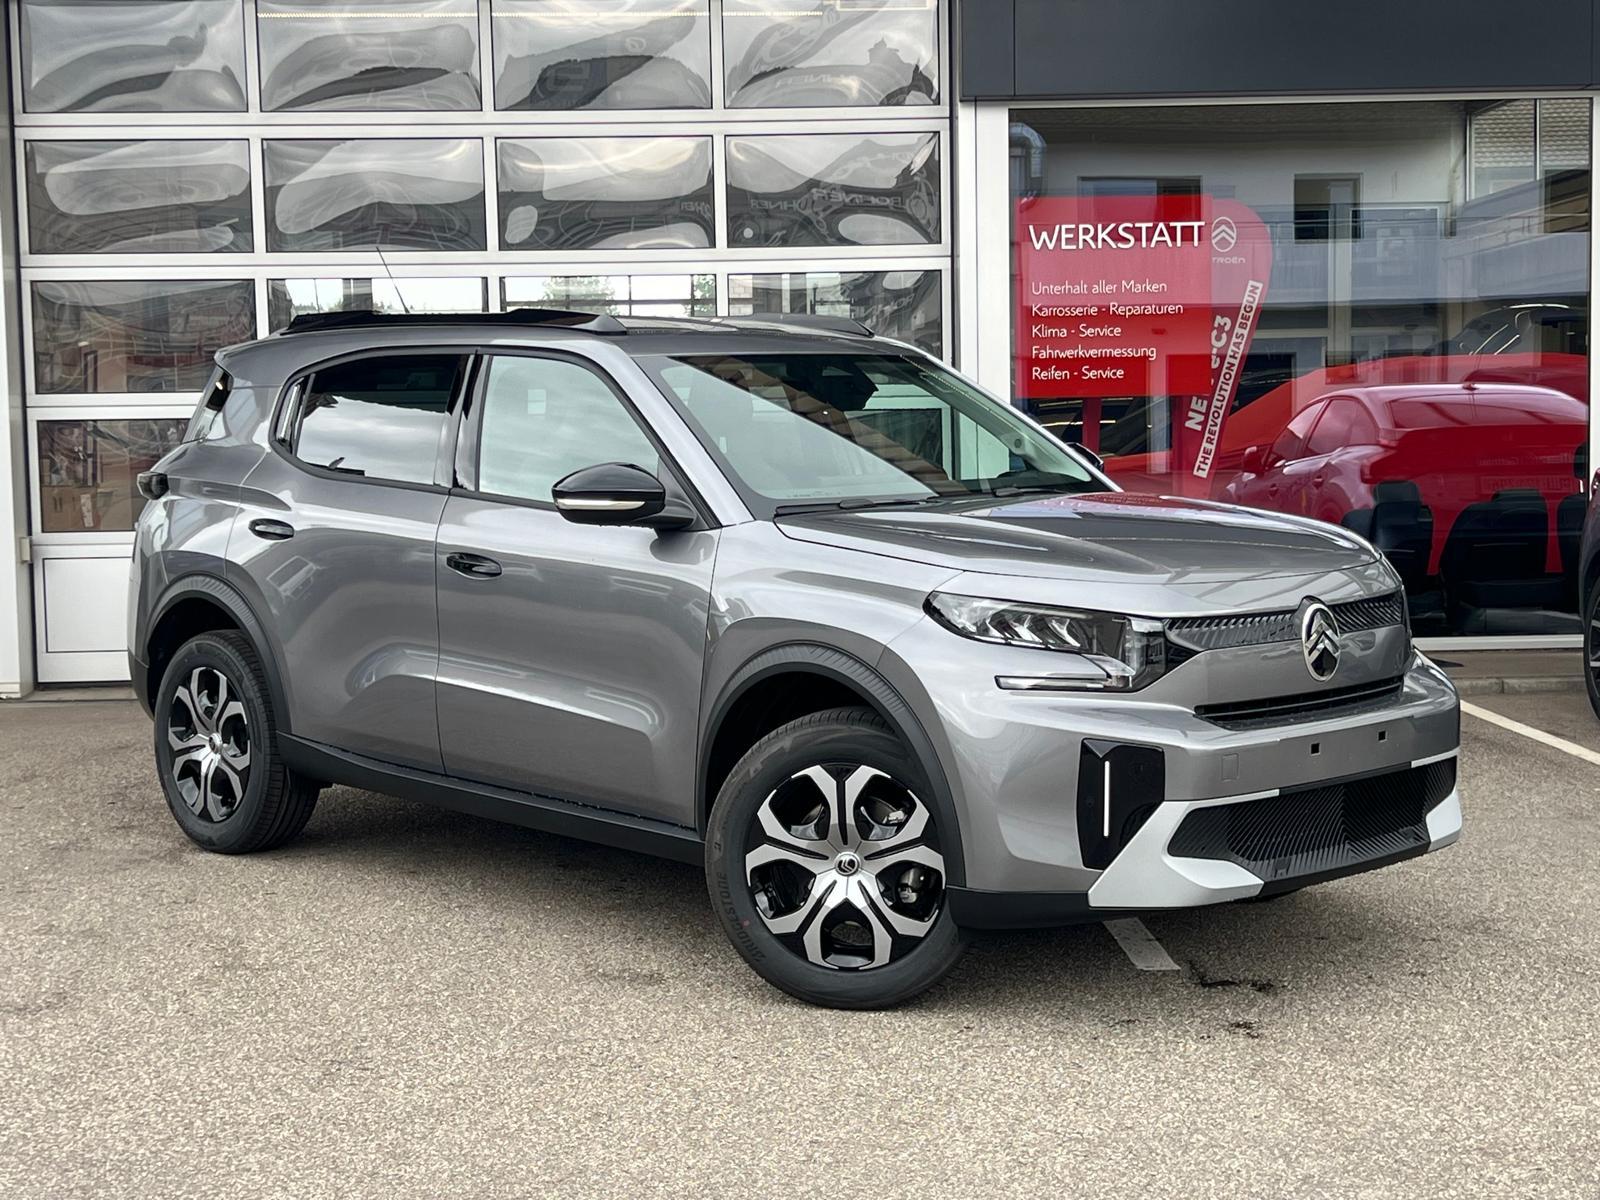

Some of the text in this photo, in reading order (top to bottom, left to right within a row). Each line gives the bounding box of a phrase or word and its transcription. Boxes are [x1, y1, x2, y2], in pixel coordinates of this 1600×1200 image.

[1028, 221, 1206, 250] WERKSTATT
[1031, 278, 1168, 295] Unterhalt aller Marken
[1031, 303, 1098, 317] Karrosserie
[1109, 302, 1184, 318] Reparaturen
[1031, 324, 1068, 338] Klima
[1079, 323, 1122, 338] Service
[1031, 344, 1157, 360] Fahrwerkvermessung
[1032, 365, 1070, 380] Reifen
[1081, 365, 1125, 380] Service
[1197, 284, 1259, 473] THE REVOLUTION HAS BEGUN
